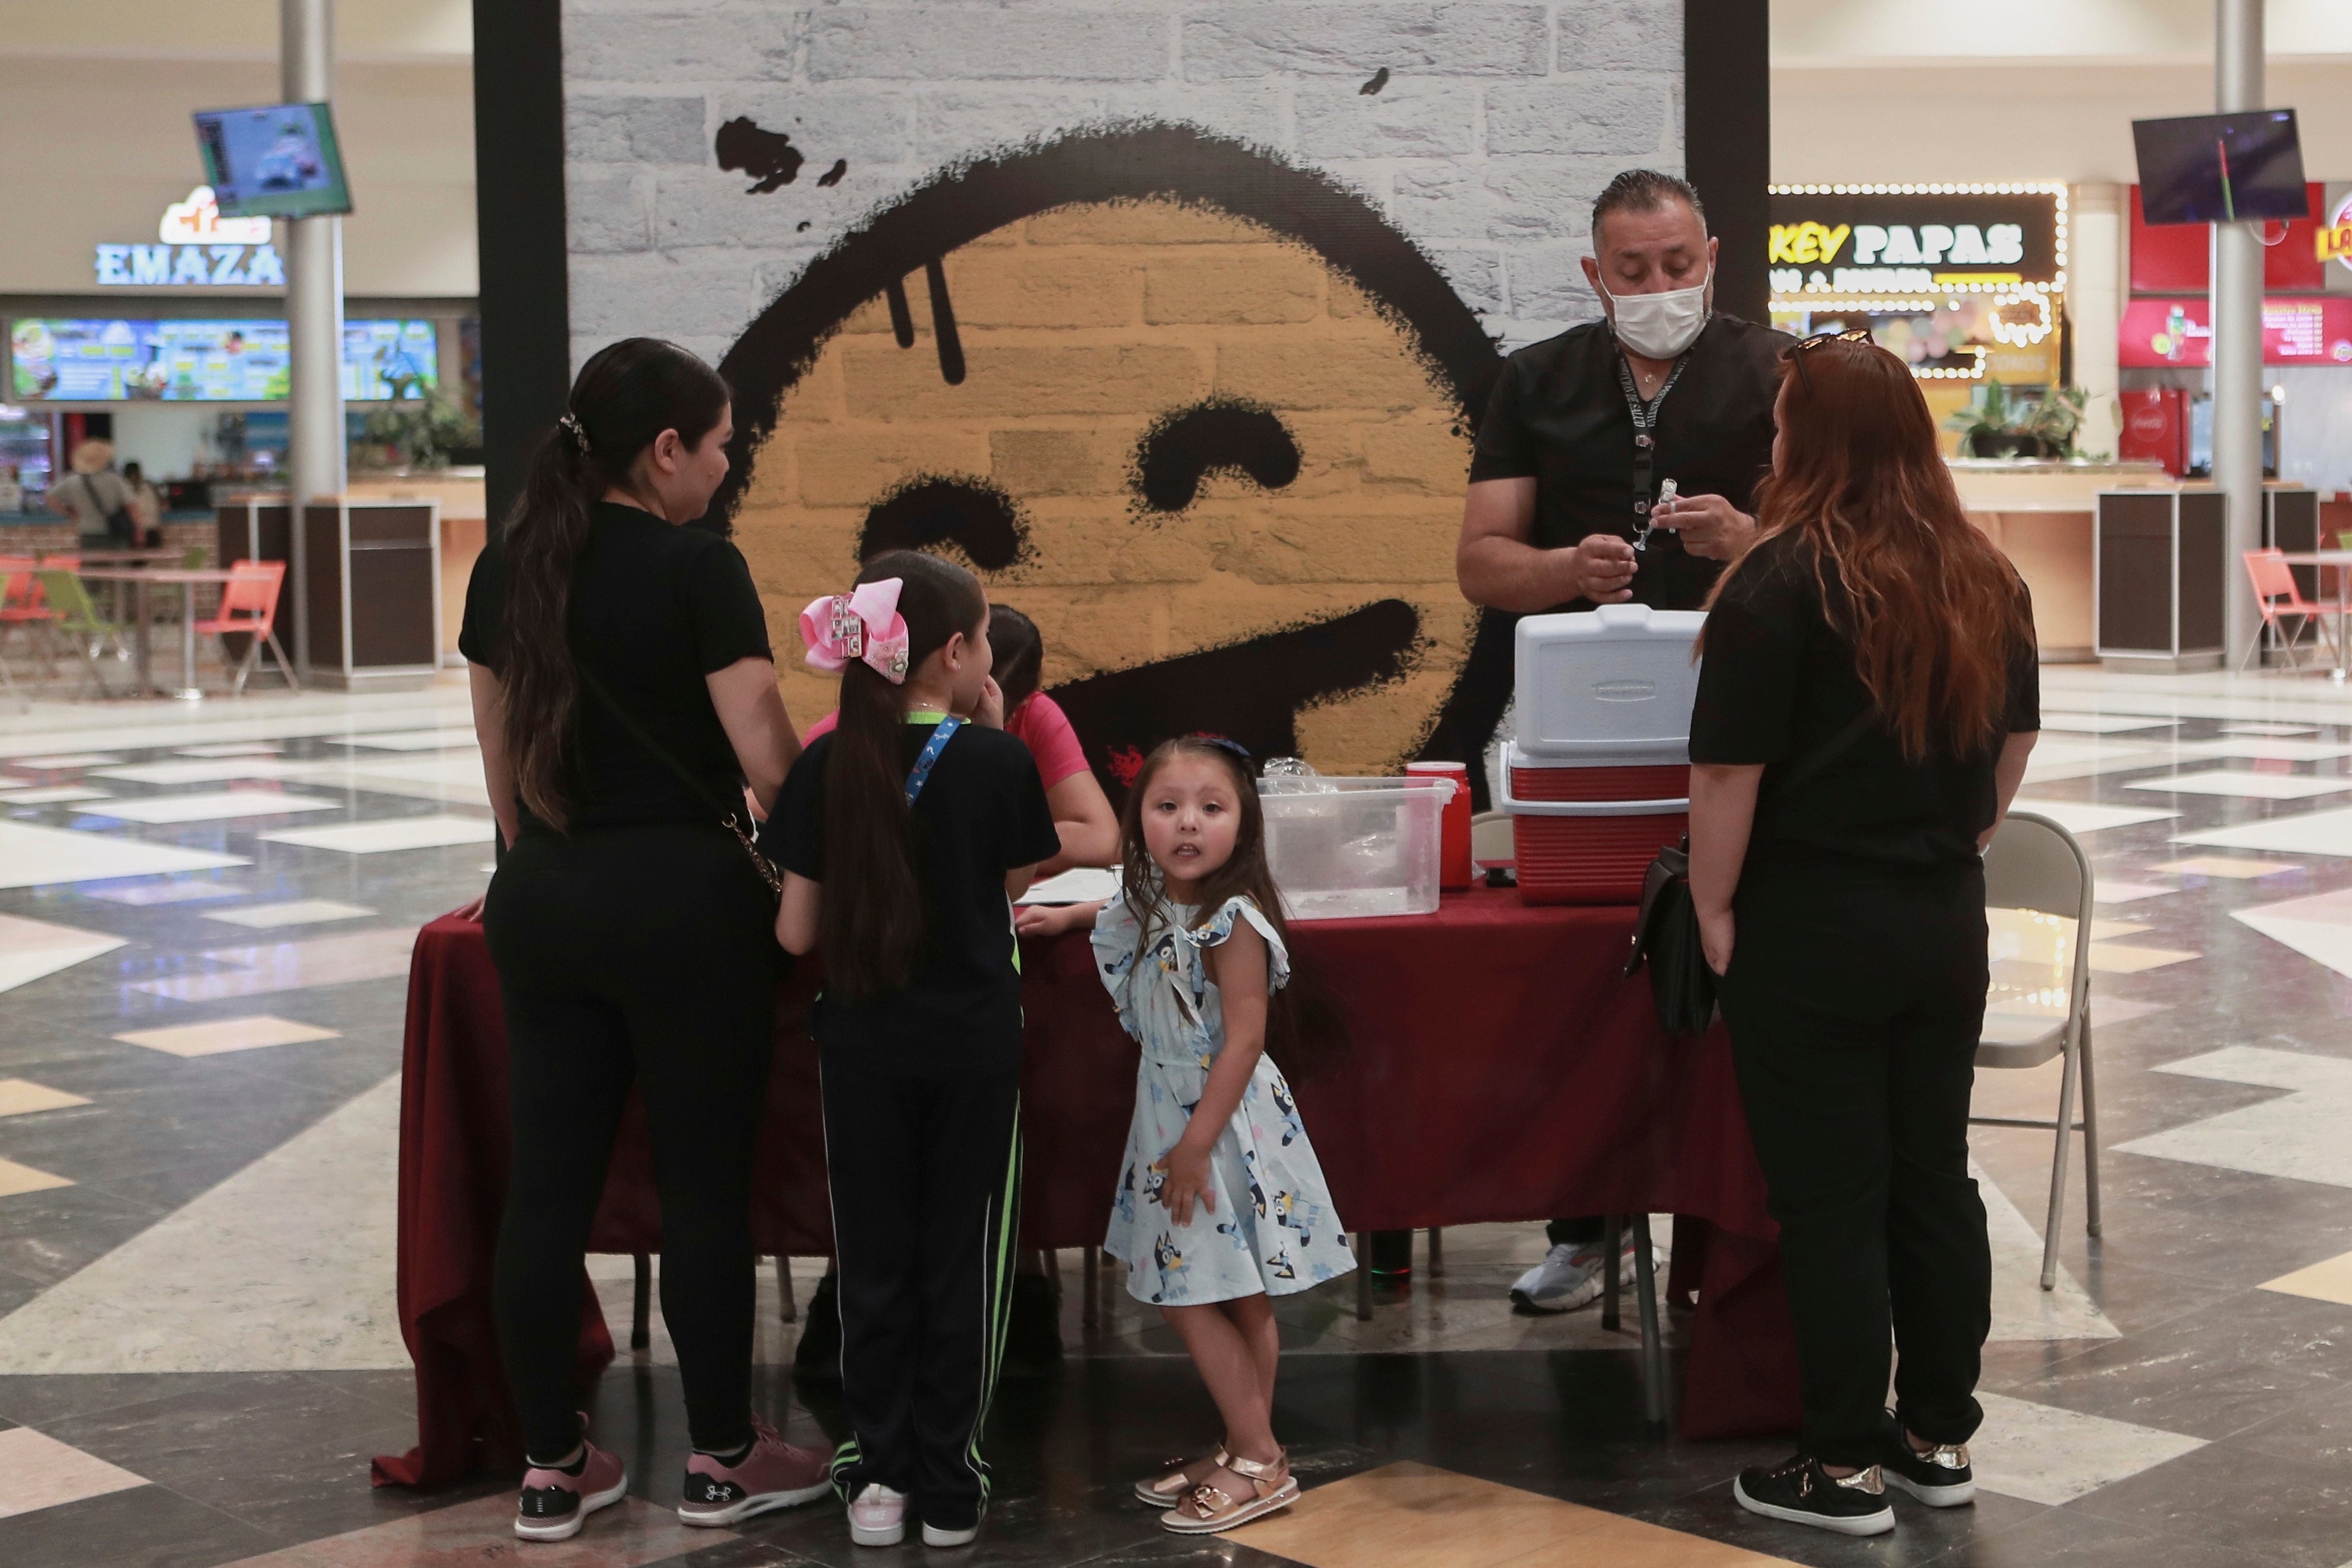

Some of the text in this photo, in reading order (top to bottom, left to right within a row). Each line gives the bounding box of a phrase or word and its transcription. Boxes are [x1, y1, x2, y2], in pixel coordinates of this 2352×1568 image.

[1853, 223, 2024, 264] PAPAS
[95, 244, 286, 285] EMAZA
[1629, 404, 1646, 427] SALUD
